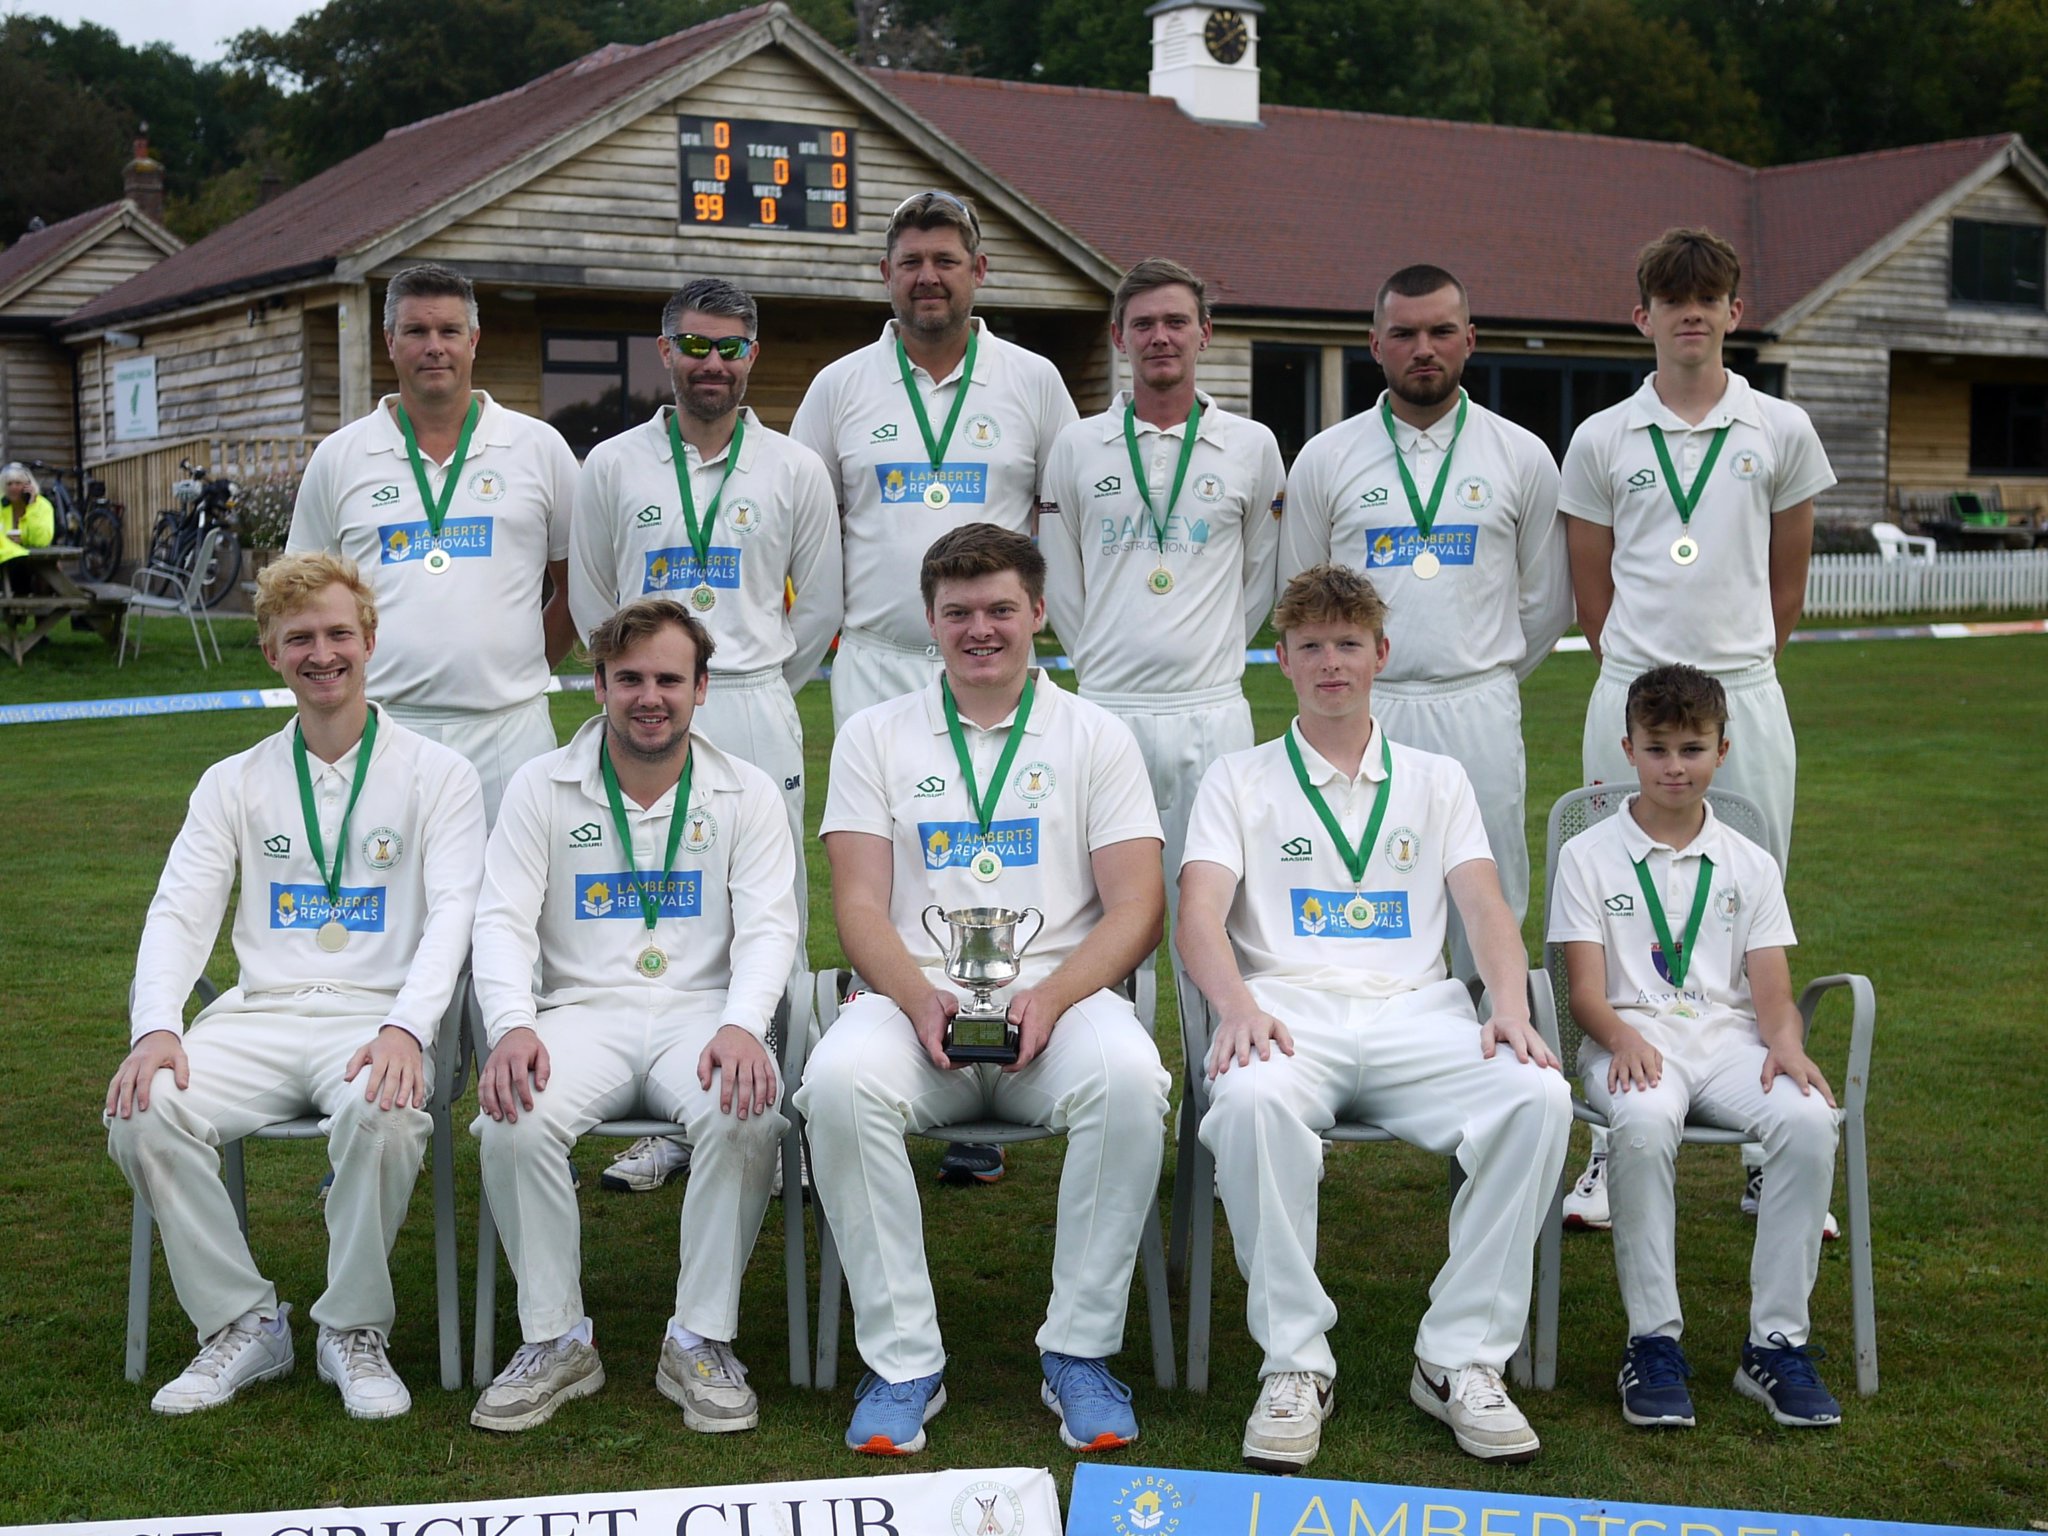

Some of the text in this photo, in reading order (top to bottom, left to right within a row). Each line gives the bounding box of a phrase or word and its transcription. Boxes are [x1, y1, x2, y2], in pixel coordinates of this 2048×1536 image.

[714, 121, 730, 149] 0
[831, 131, 847, 158] 0
[747, 144, 790, 159] TOTAL
[714, 153, 731, 181] 0
[773, 158, 790, 185] 0
[831, 162, 847, 189] 0
[694, 193, 724, 221] 99
[760, 197, 776, 224] 0
[831, 202, 847, 229] 0
[909, 482, 981, 494] REVALS
[672, 555, 737, 568] LAMERTS
[1028, 802, 1038, 810] JU
[1328, 901, 1402, 914] LAERTS
[1330, 914, 1403, 928] REVALS
[1112, 1475, 1183, 1509] LAMBERTS
